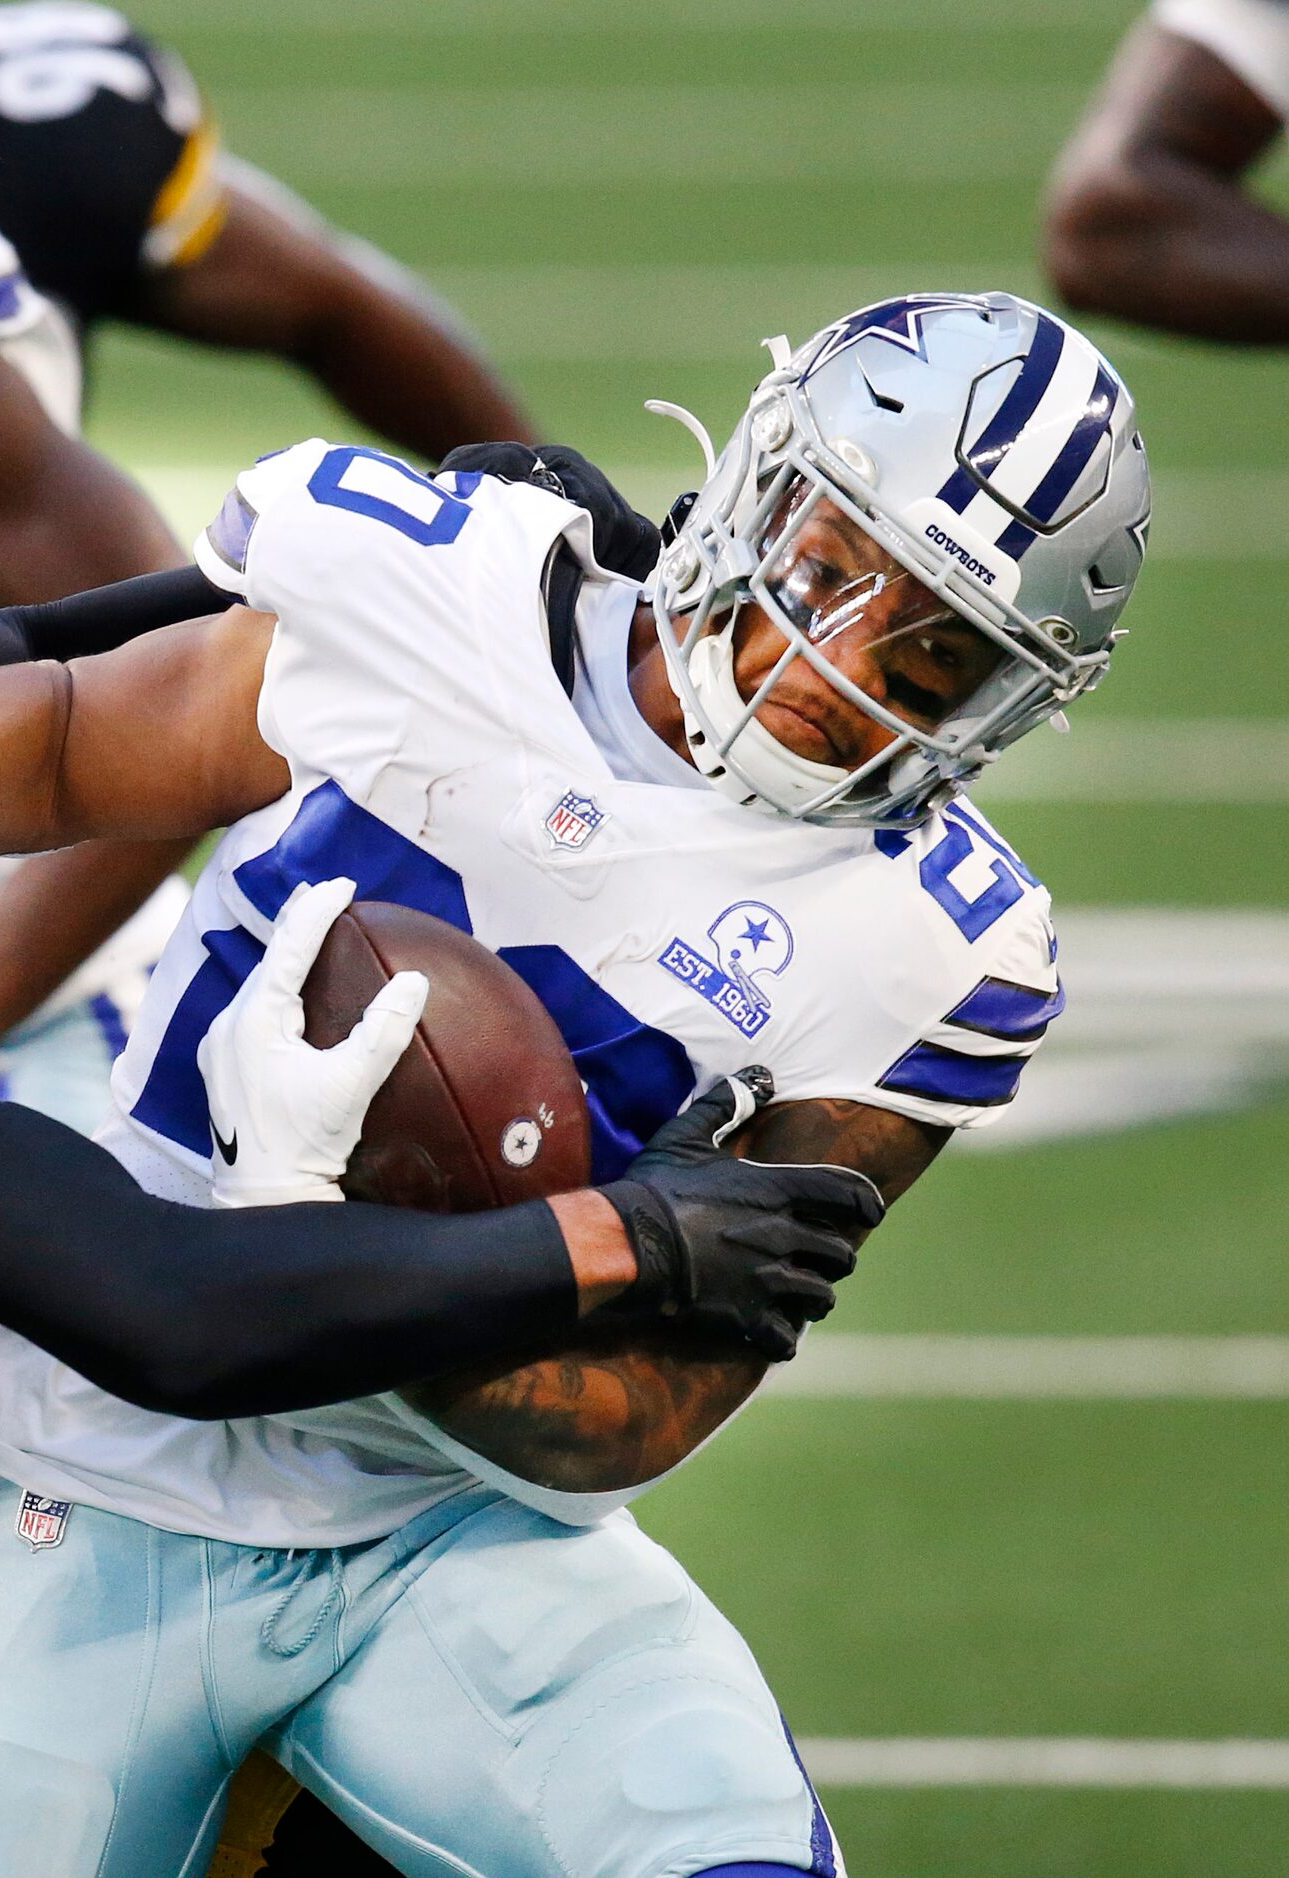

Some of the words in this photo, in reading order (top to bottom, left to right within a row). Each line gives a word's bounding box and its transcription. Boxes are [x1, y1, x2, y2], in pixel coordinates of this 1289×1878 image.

[924, 523, 997, 586] COWBOYS
[549, 806, 588, 844] NFL
[662, 942, 715, 991] EST.
[711, 981, 764, 1033] 1960
[20, 1510, 57, 1541] NFL
